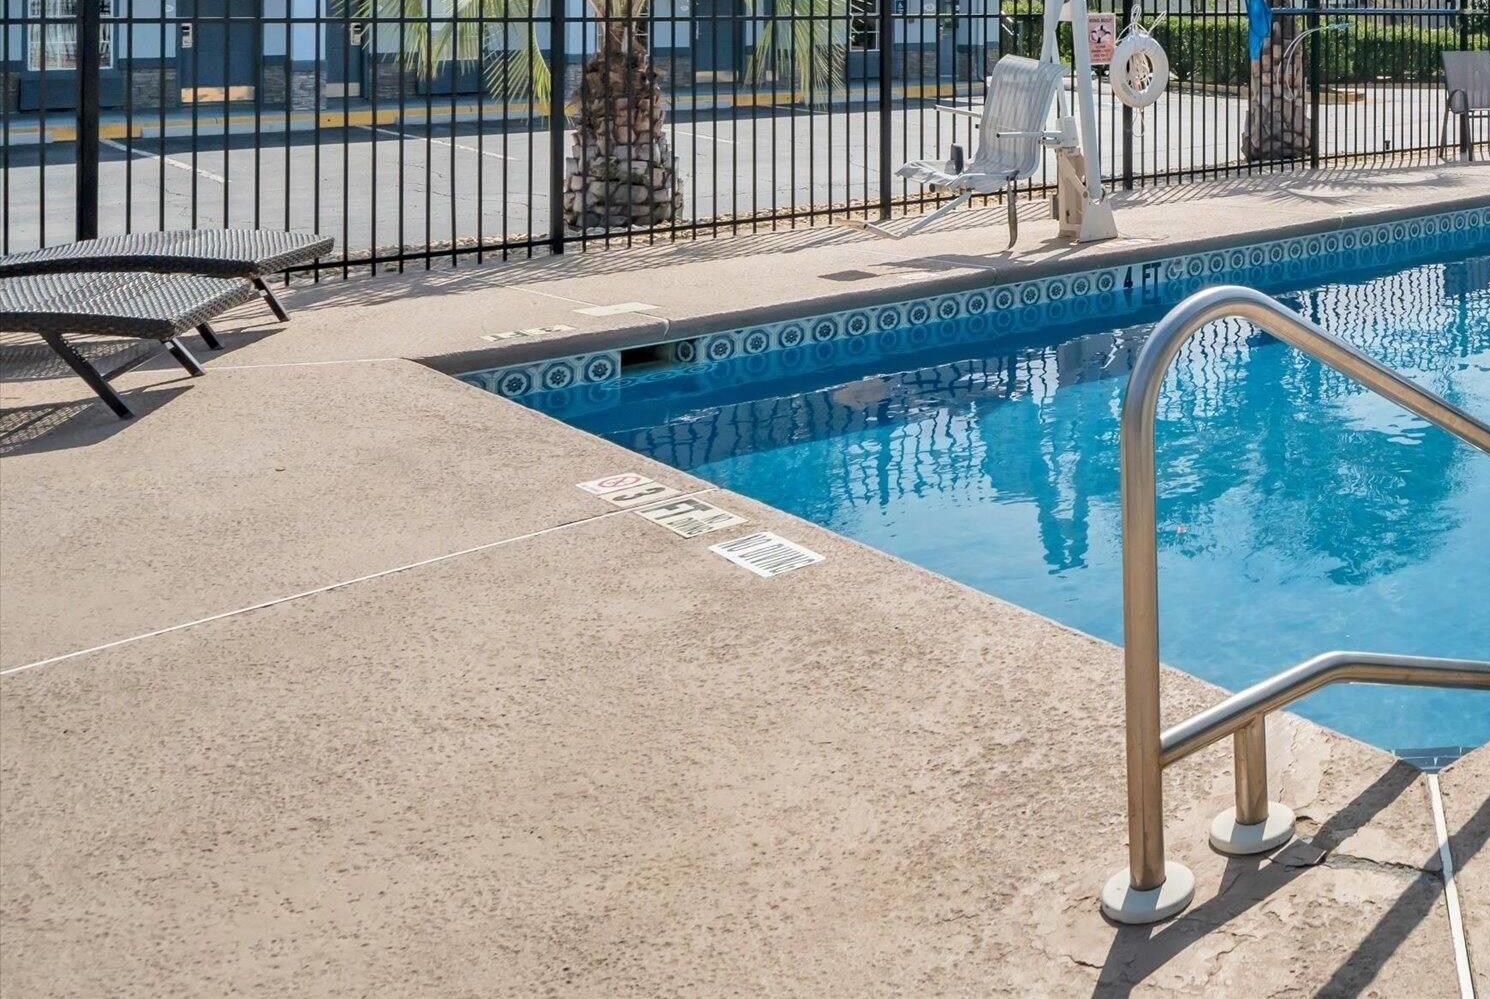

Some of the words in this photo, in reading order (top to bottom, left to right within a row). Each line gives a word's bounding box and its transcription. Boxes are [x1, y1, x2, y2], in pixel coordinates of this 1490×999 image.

[1123, 266, 1133, 288] 4
[1142, 262, 1161, 288] FT
[612, 486, 666, 502] 3
[640, 498, 713, 521] FT
[717, 533, 773, 552] NO
[738, 543, 816, 573] DIVING
